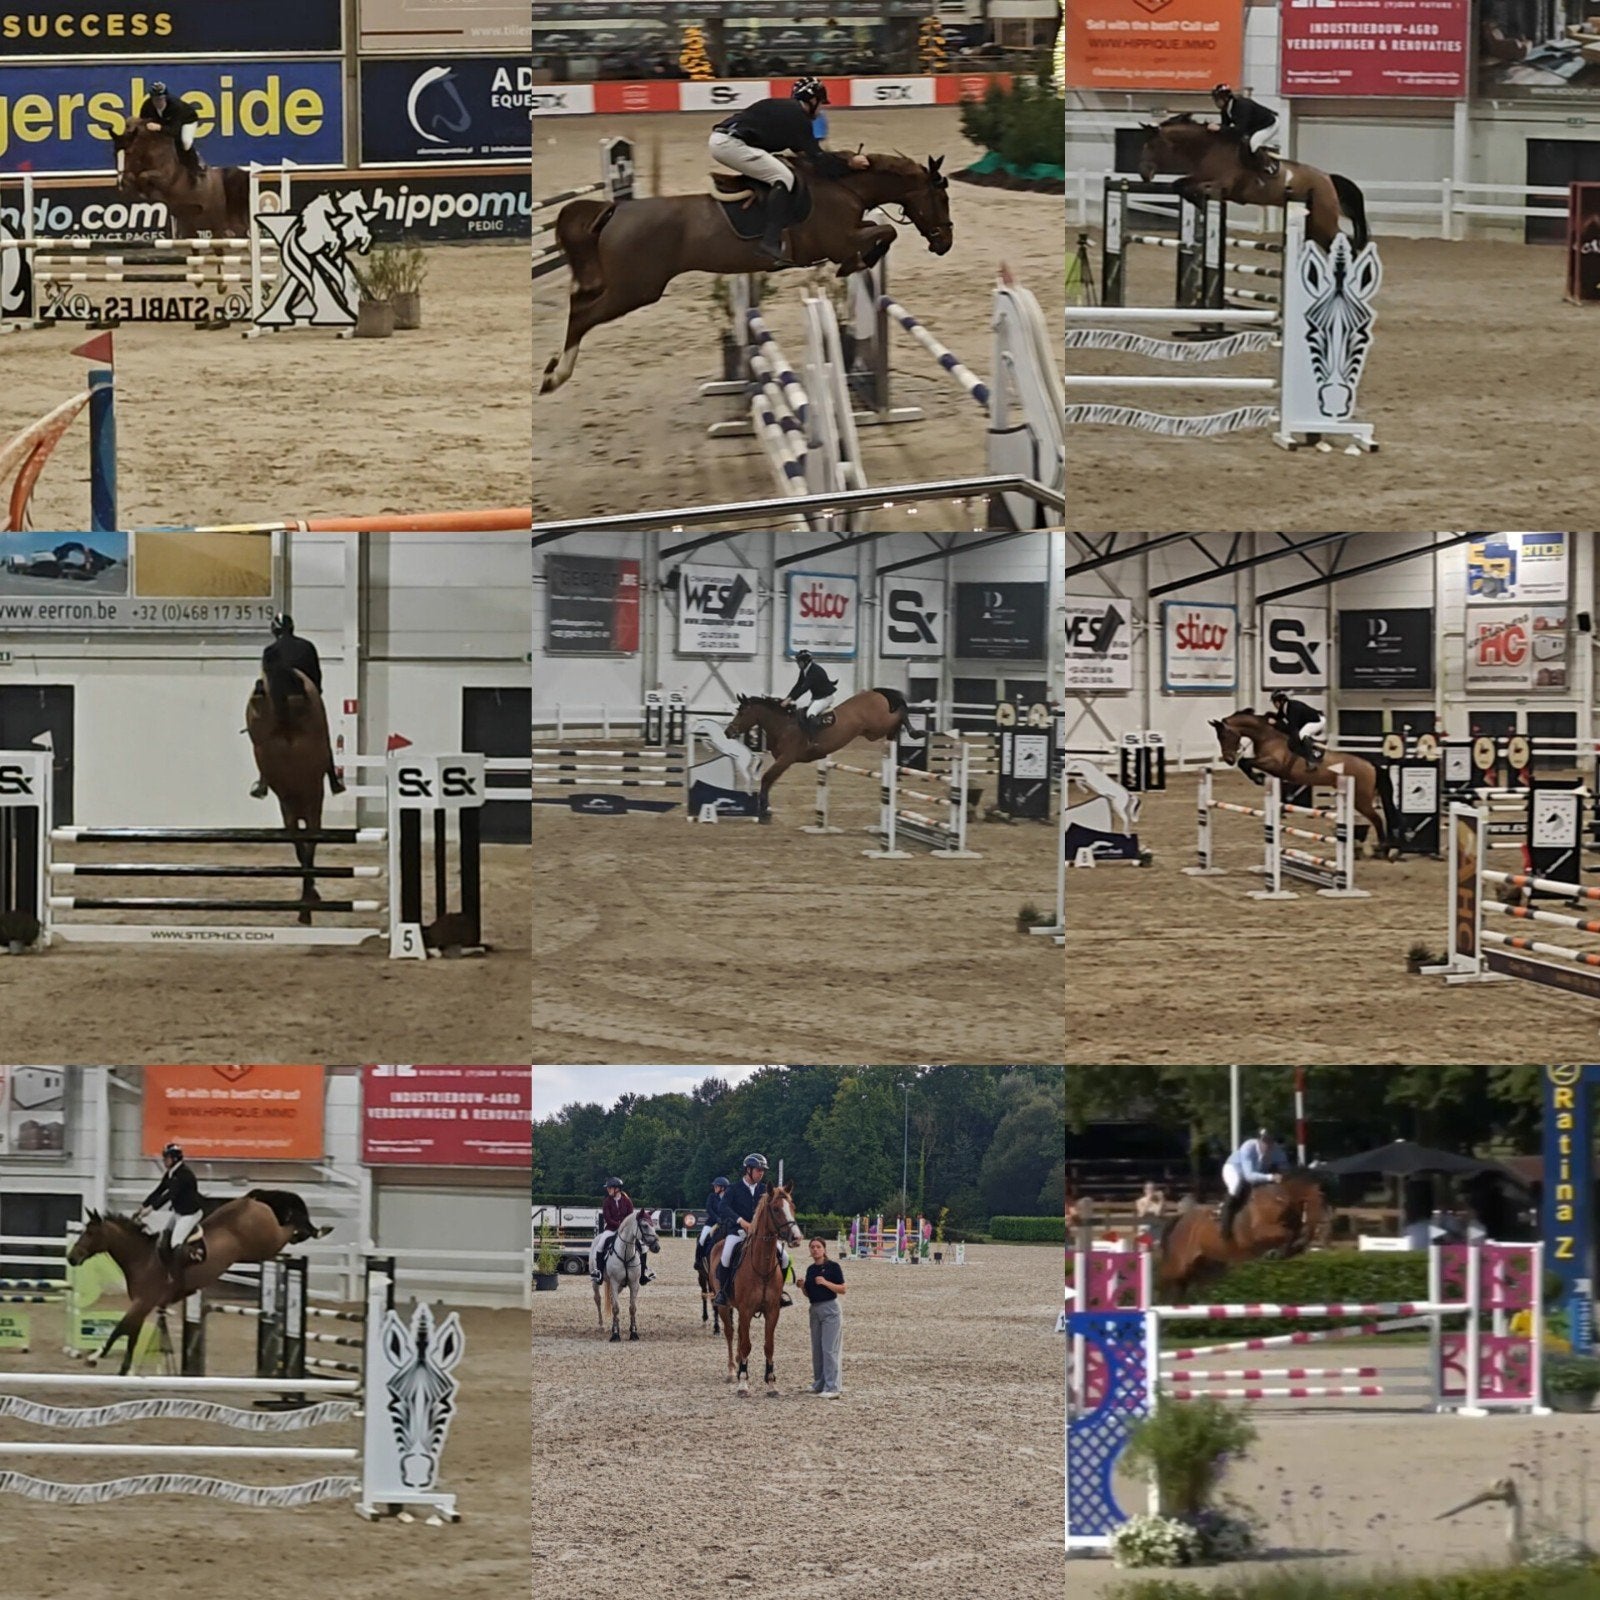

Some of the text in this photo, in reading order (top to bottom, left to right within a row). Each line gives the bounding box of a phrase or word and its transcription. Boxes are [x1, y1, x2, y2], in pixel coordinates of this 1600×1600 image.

[2, 13, 173, 38] SUCCESS
[1309, 23, 1439, 35] INDUSTRIEBOUW-AGRO
[1287, 39, 1462, 52] VERBOUWINGEN & RENOVATIES
[132, 605, 157, 620] +32
[162, 605, 209, 621] (0)468
[214, 605, 230, 620] 17
[235, 606, 252, 620] 35
[258, 606, 274, 620] 19
[1175, 613, 1228, 650] stico
[403, 930, 413, 952] 5
[367, 1108, 456, 1119] VERBOUWINGEN
[1553, 1087, 1575, 1259] Ratina Z
